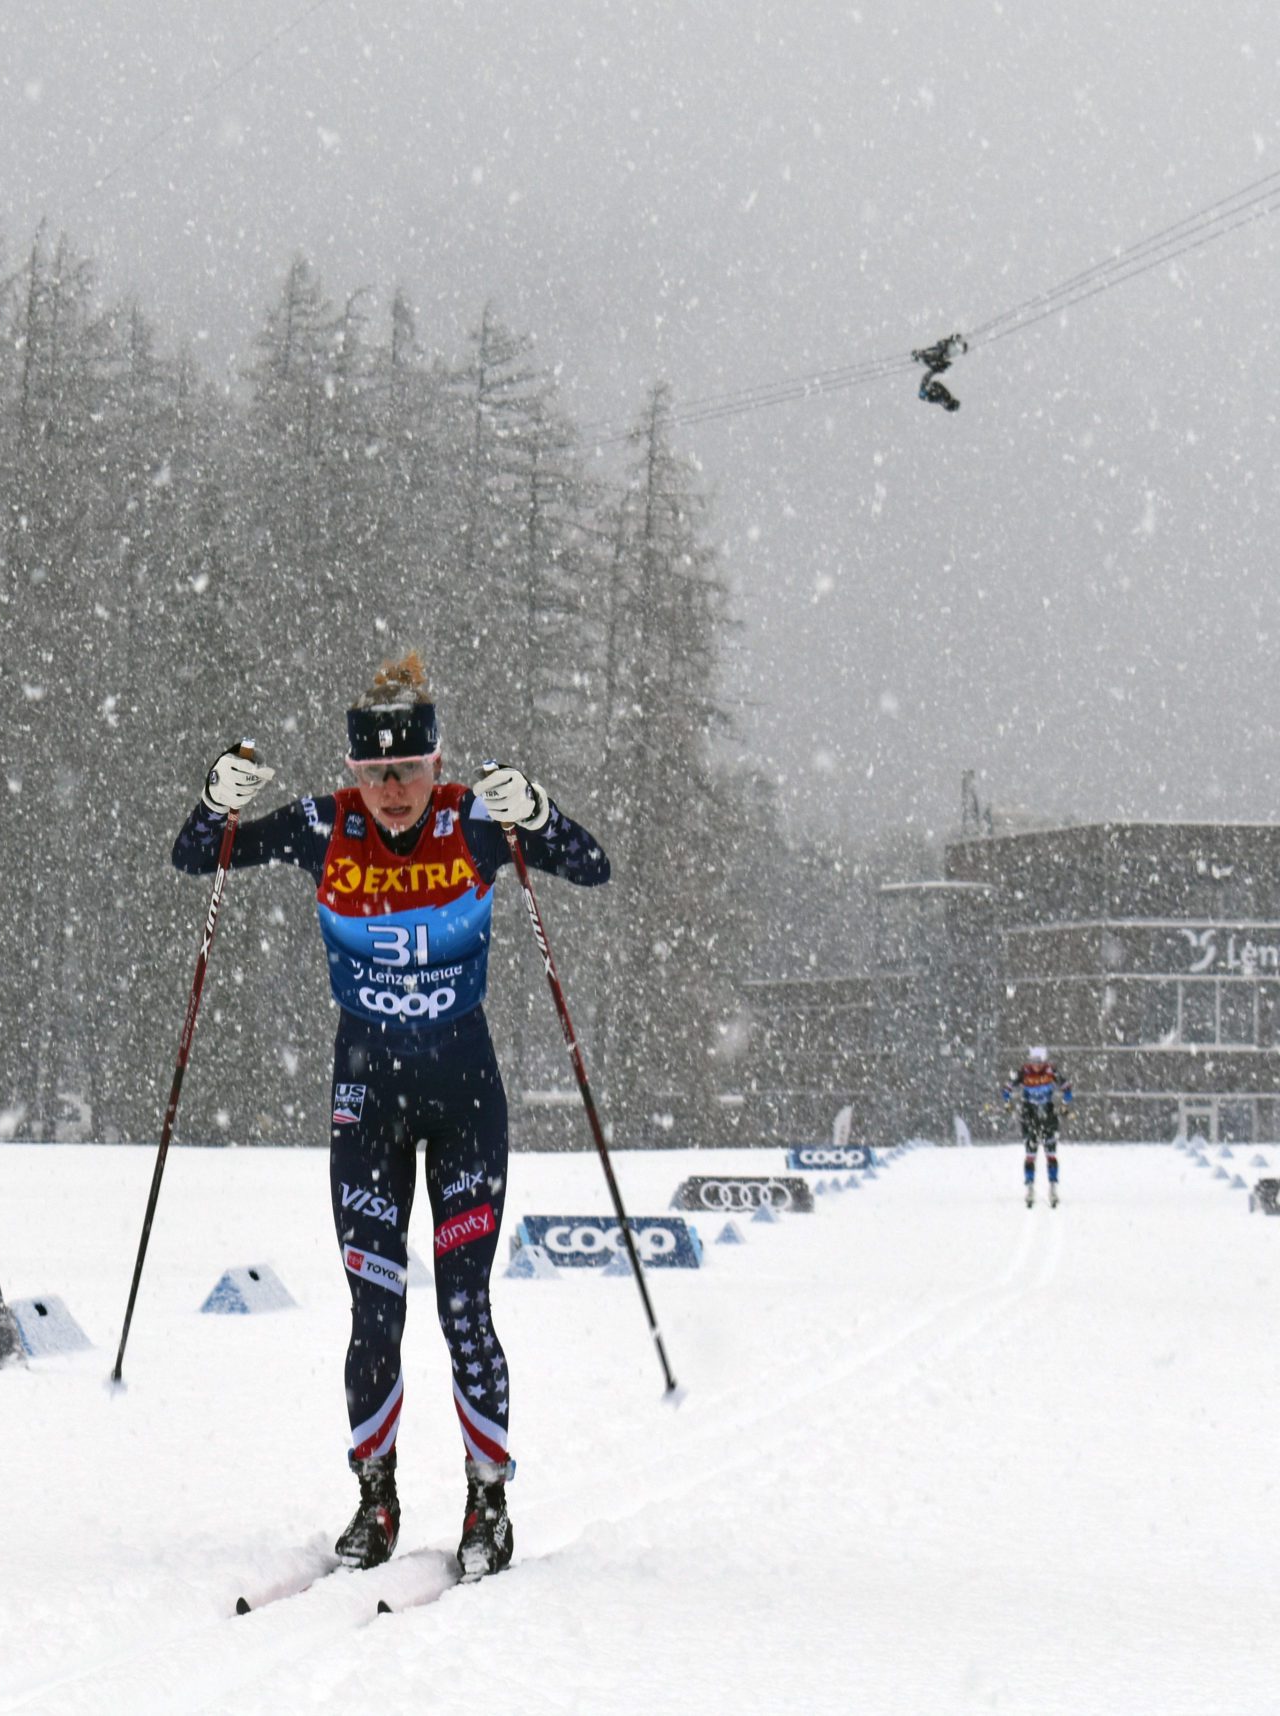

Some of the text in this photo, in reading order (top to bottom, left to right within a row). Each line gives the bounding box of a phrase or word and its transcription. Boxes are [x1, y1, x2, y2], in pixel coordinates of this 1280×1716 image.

[363, 857, 475, 894] EXTRA
[367, 924, 429, 967] 31
[359, 986, 456, 1020] coop
[336, 1085, 365, 1098] US
[799, 1150, 866, 1168] coop
[340, 1182, 399, 1228] VISA
[434, 1211, 490, 1251] xfinity
[544, 1225, 677, 1261] coop
